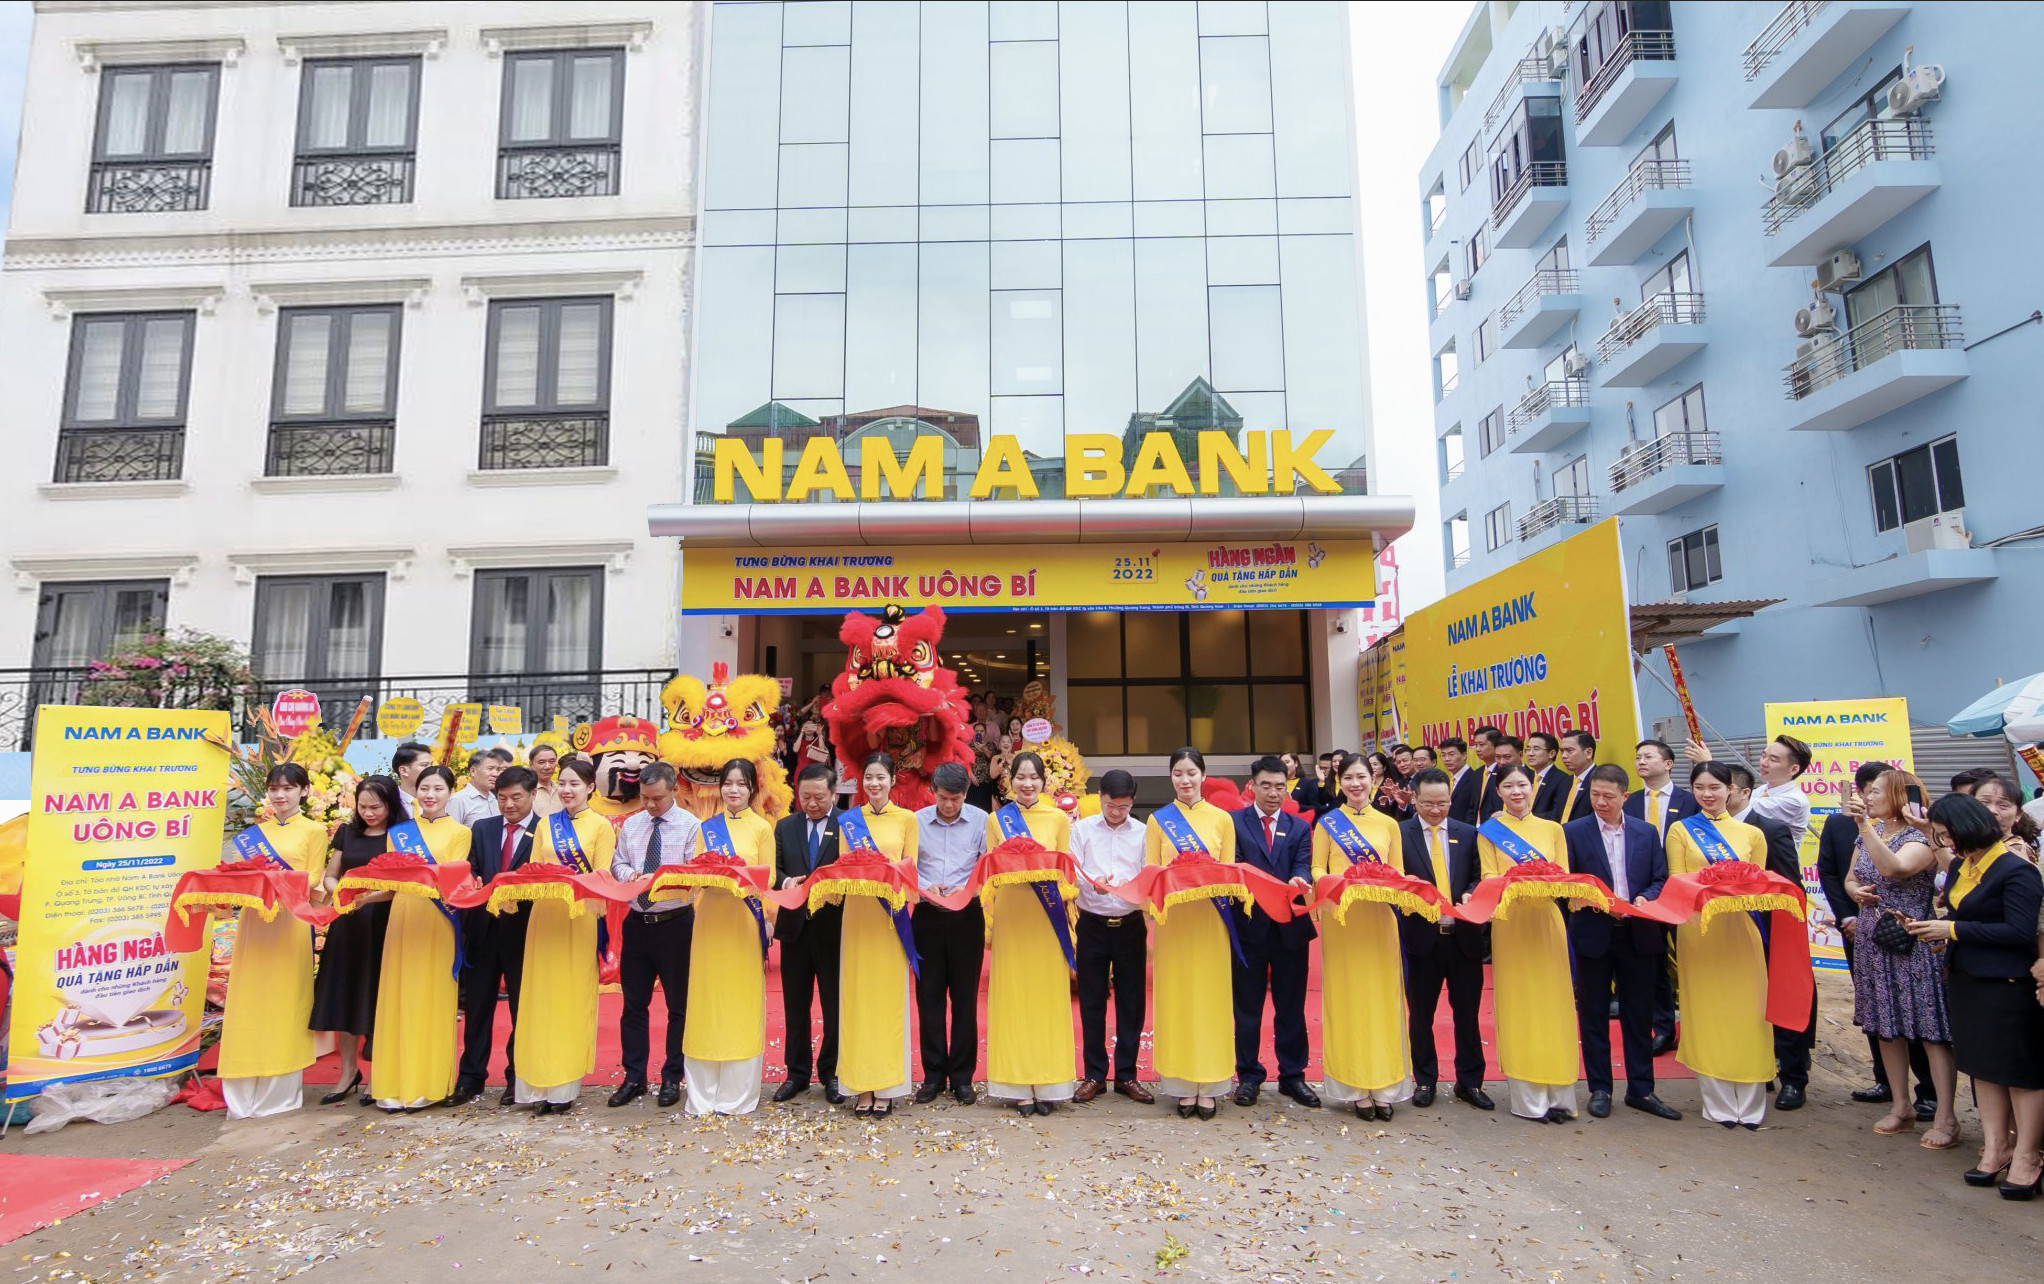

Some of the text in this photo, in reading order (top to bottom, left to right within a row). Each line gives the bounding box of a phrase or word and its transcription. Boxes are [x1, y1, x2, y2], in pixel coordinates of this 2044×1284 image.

[713, 428, 1345, 502] NAM A BANK
[808, 556, 839, 567] KHAI
[842, 555, 893, 567] TRƯƠNG
[1115, 557, 1150, 567] 25.11
[1208, 542, 1296, 568] HÀNG NGÀN
[733, 568, 1037, 599] NAM A BANK UÔNG BÍ
[1112, 569, 1153, 580] 2022
[1447, 590, 1537, 646] NAM A BANK
[1447, 652, 1547, 699] LỄ KHAI TRƯƠNG
[1422, 720, 1450, 750] NAM
[1514, 699, 1572, 742] UÔNG
[1577, 688, 1601, 741] BÍ
[1783, 712, 1888, 726] NAM A BANK
[64, 726, 209, 740] NAM A BANK
[132, 765, 156, 773] KHAI
[159, 764, 198, 773] TRƯƠNG
[1829, 759, 1843, 773] A
[1849, 758, 1906, 773] BK
[43, 789, 218, 813] NAM A BANK
[73, 813, 192, 842] UÔNG BÍ
[96, 857, 164, 870] Ngày 25/11/2022
[122, 874, 140, 882] Nam
[57, 931, 171, 971] HÀNG NGÀ
[56, 957, 180, 989] QUÀ TẶNG HẤP DẪN
